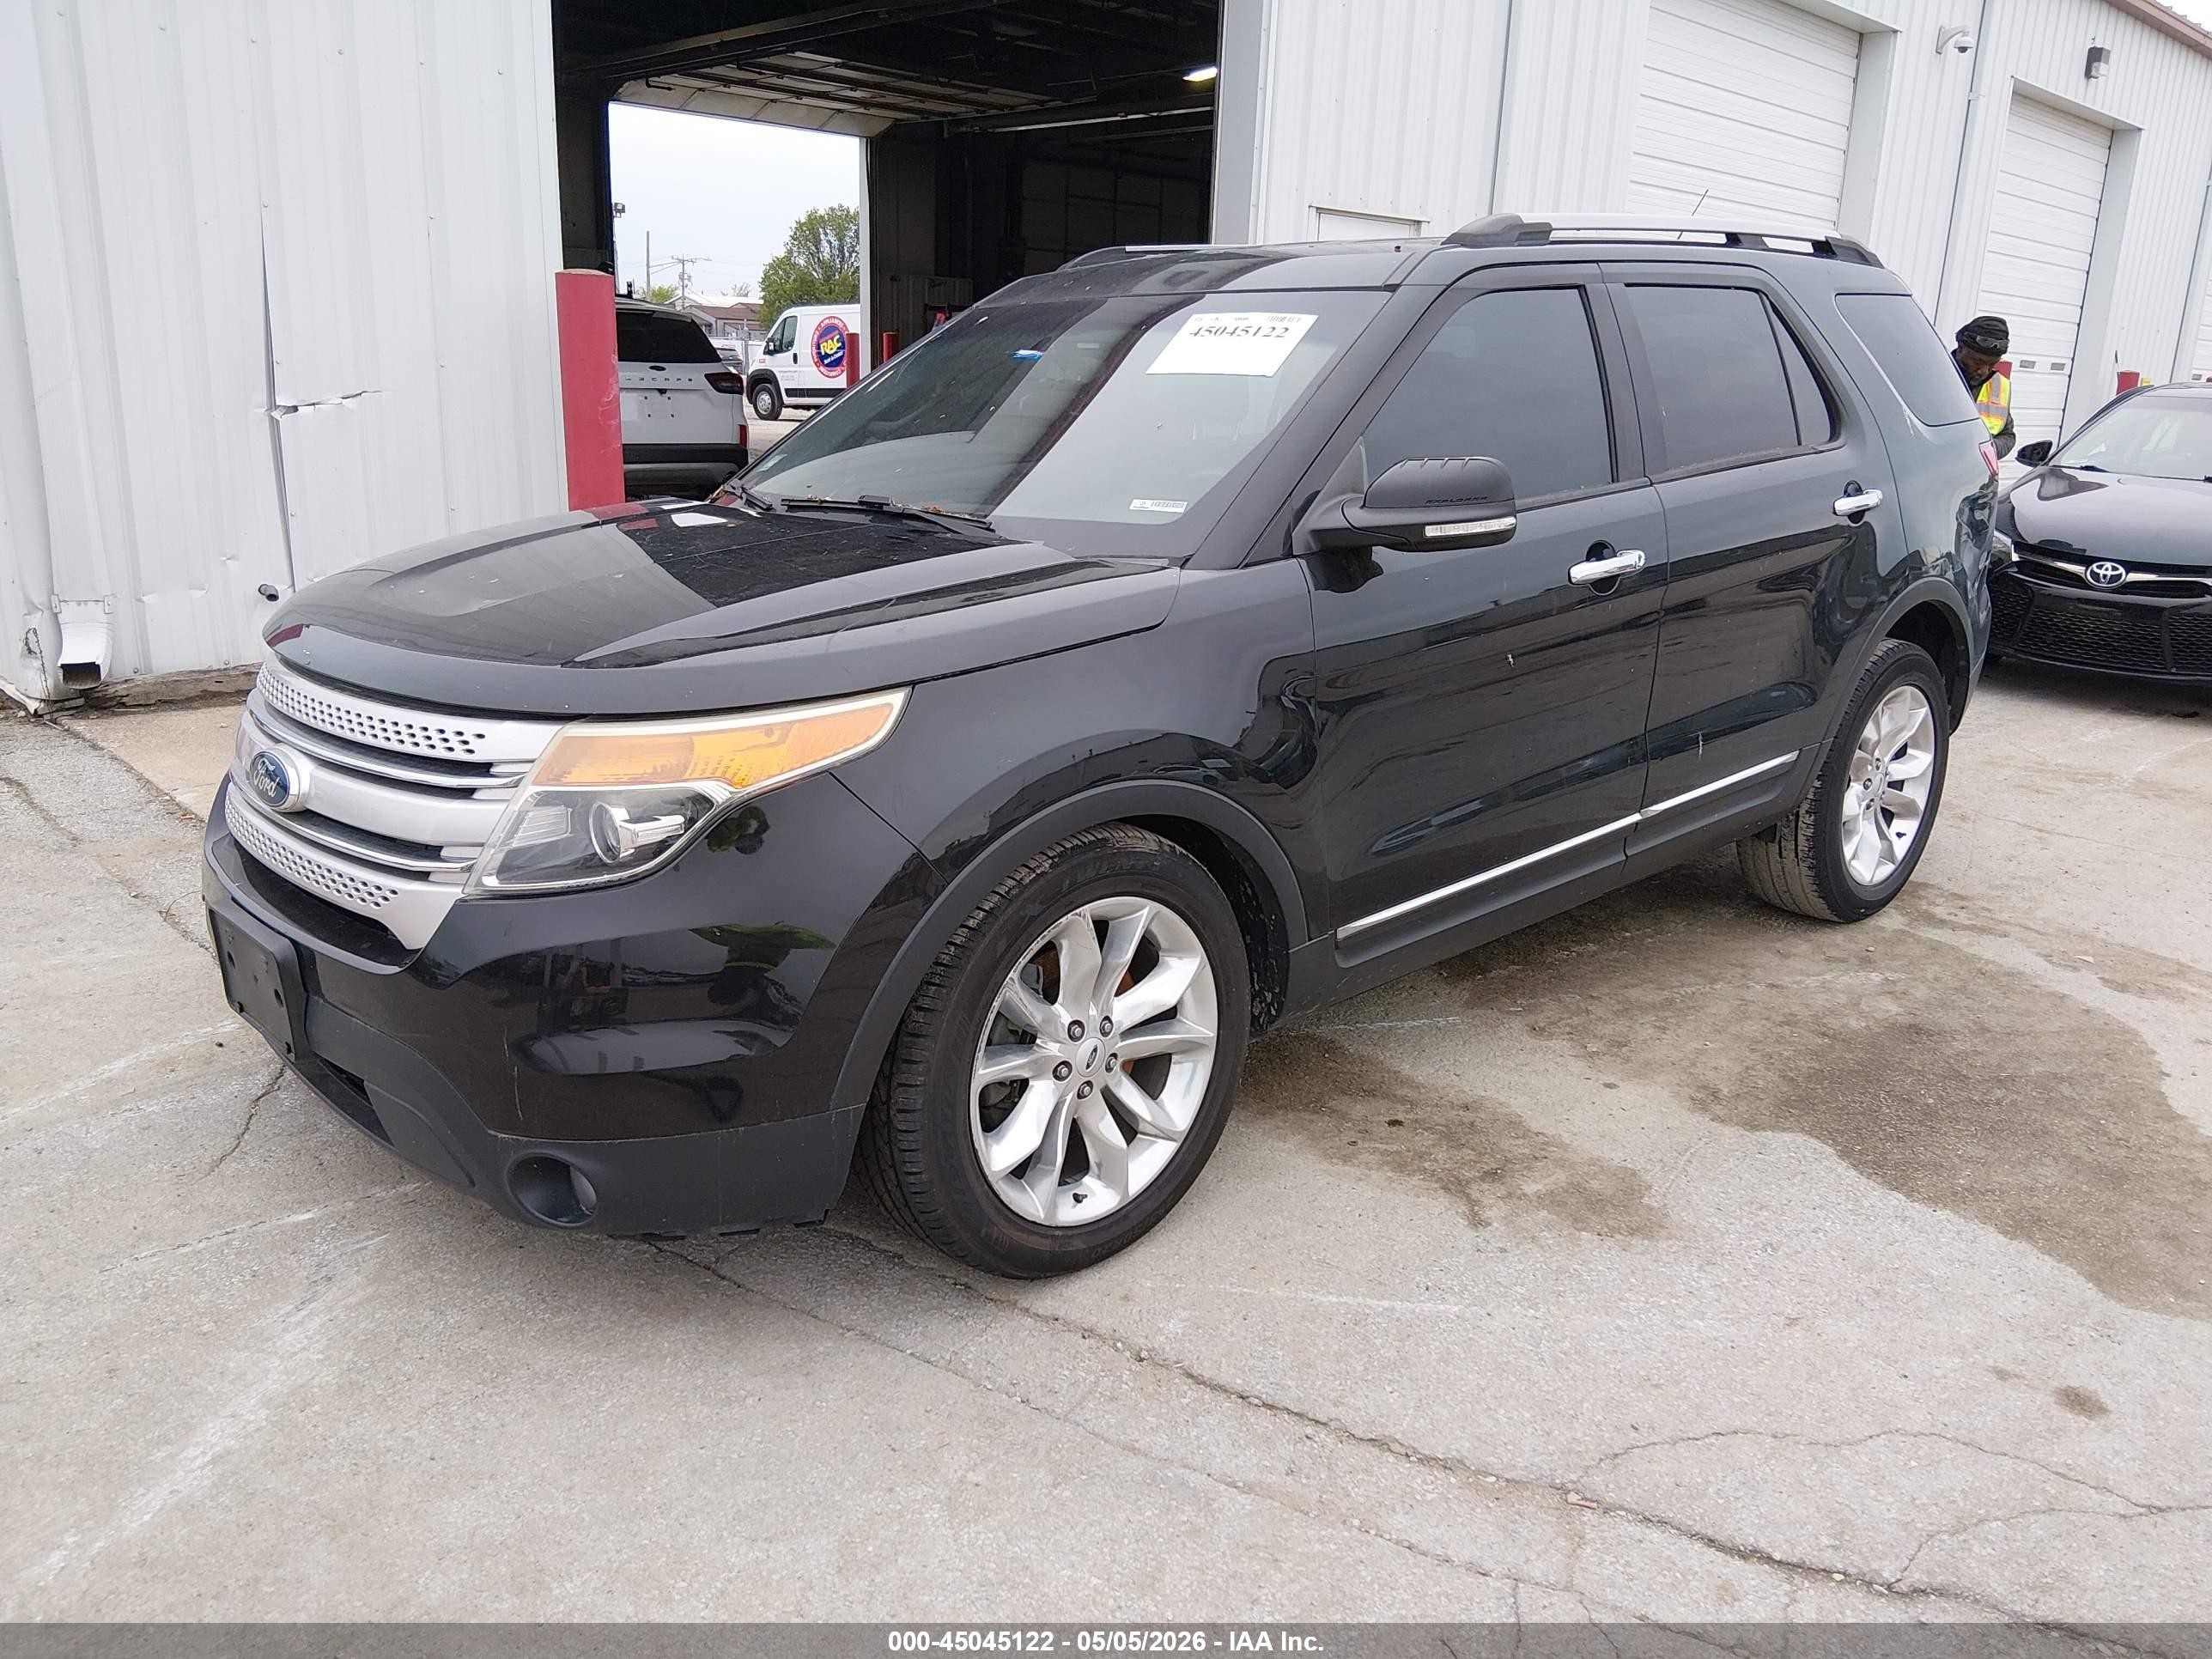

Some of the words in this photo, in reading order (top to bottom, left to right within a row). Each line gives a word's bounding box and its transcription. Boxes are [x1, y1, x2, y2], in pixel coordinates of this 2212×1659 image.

[1188, 325, 1290, 338] 45045122
[820, 334, 842, 356] RAC
[1425, 495, 1488, 505] EXPLORER
[253, 757, 280, 798] Ford
